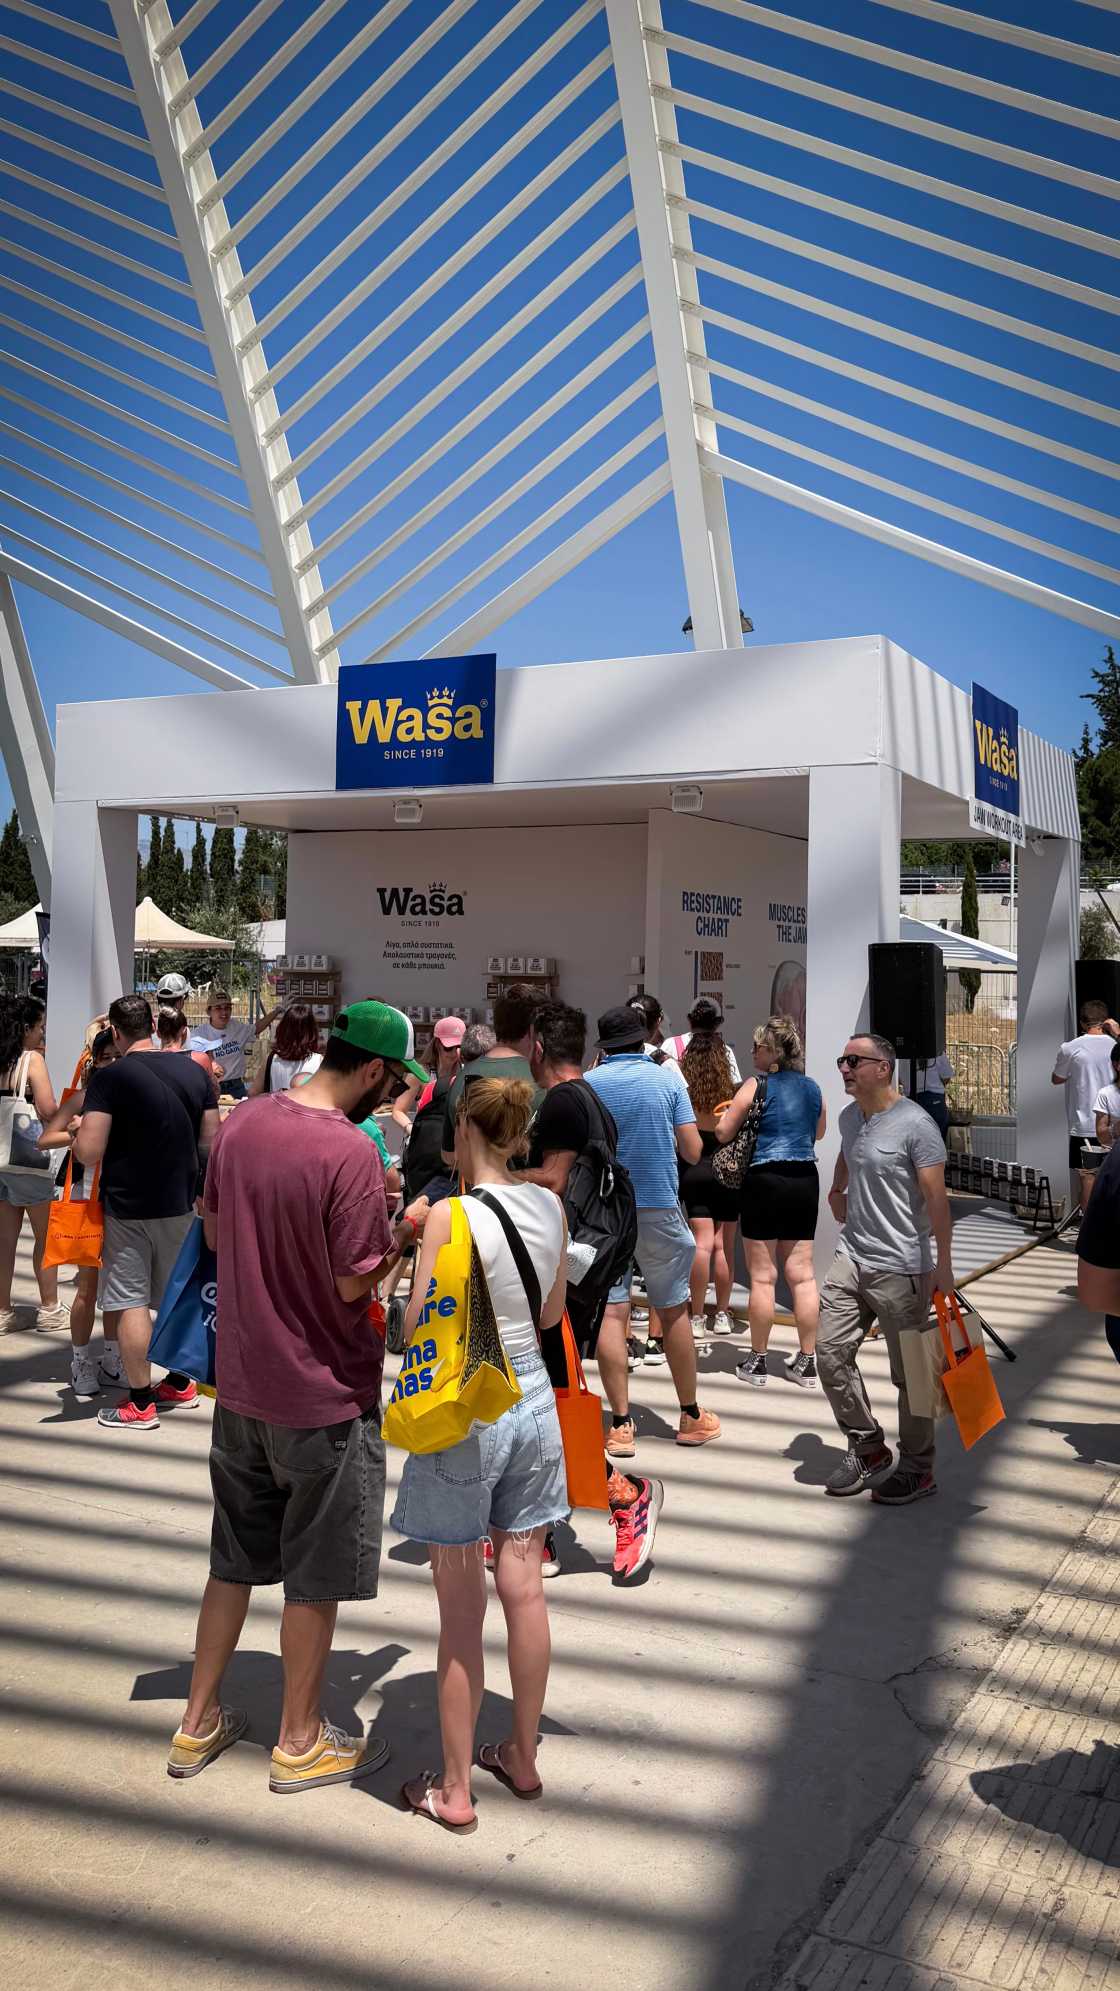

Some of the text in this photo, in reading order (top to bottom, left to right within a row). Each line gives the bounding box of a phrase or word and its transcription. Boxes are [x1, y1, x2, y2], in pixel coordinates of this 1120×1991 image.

[345, 697, 484, 745] Wasa
[384, 748, 444, 760] SINCE 1919
[975, 720, 1018, 781] Wasa
[376, 887, 464, 916] Wasa
[682, 890, 742, 917] RESISTANCE
[768, 902, 806, 924] MUSCLES
[695, 915, 730, 938] CHART
[776, 924, 792, 944] THE
